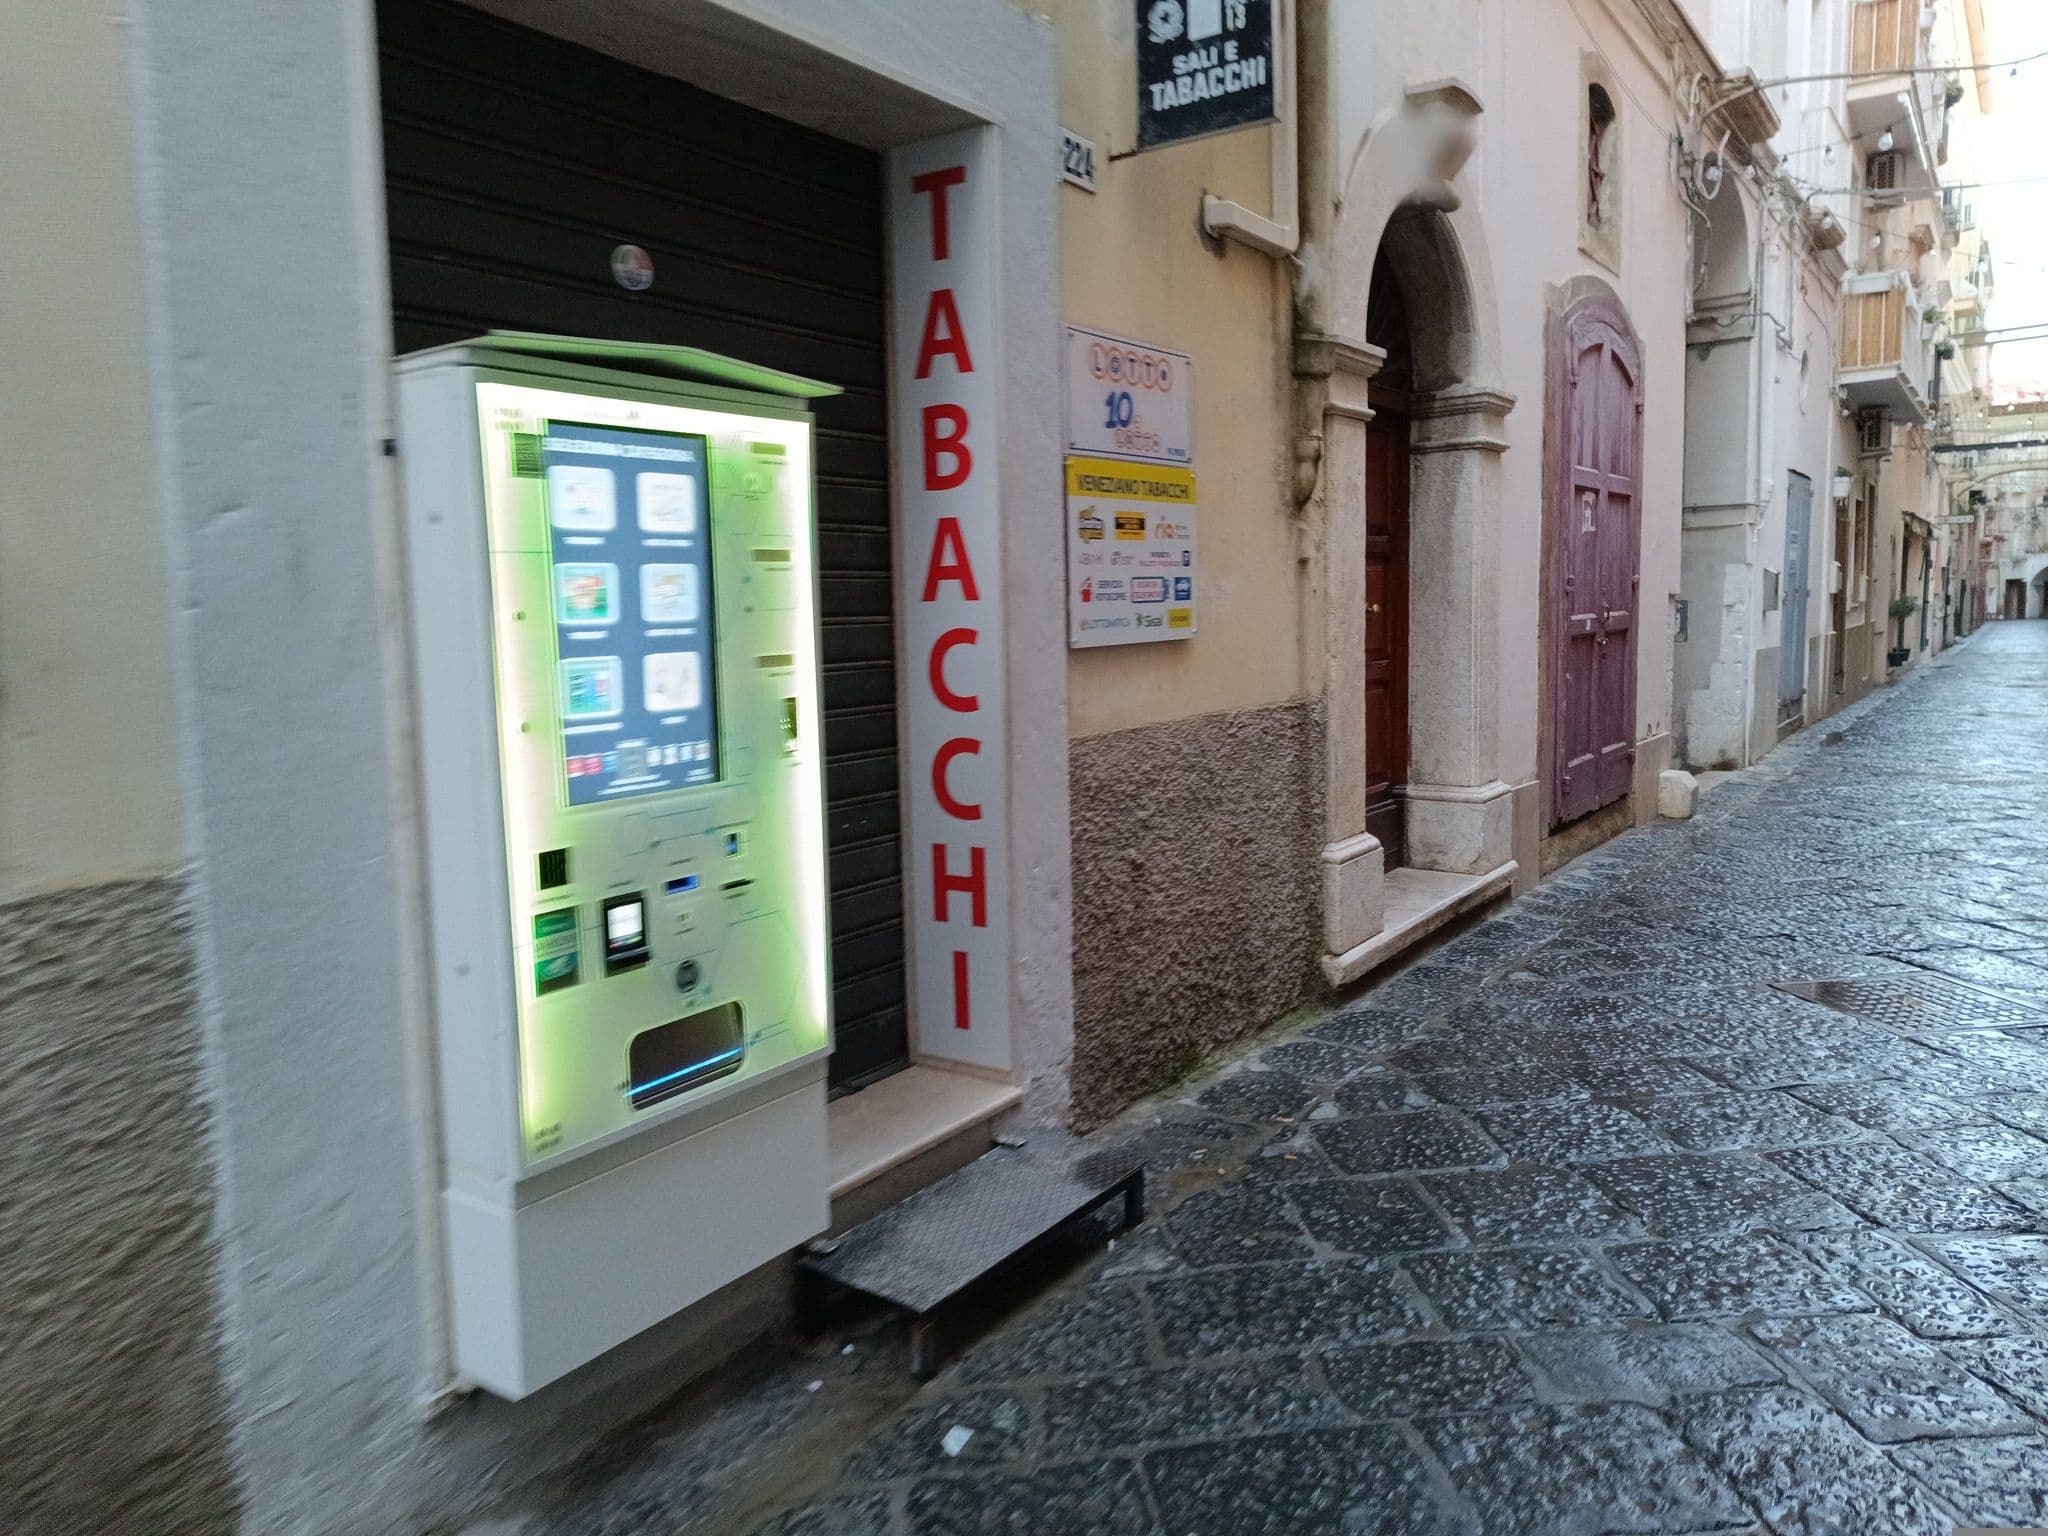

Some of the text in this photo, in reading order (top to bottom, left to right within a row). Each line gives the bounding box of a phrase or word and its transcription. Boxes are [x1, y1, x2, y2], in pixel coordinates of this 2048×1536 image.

[1172, 40, 1239, 75] SALI E
[1149, 55, 1266, 112] TABACCHI
[1063, 136, 1094, 178] 224
[1089, 341, 1173, 392] LOTTO
[1104, 391, 1133, 429] 10
[1079, 474, 1190, 500] VENEZIANO TABACCHI
[911, 165, 988, 1031] TABACCHI
